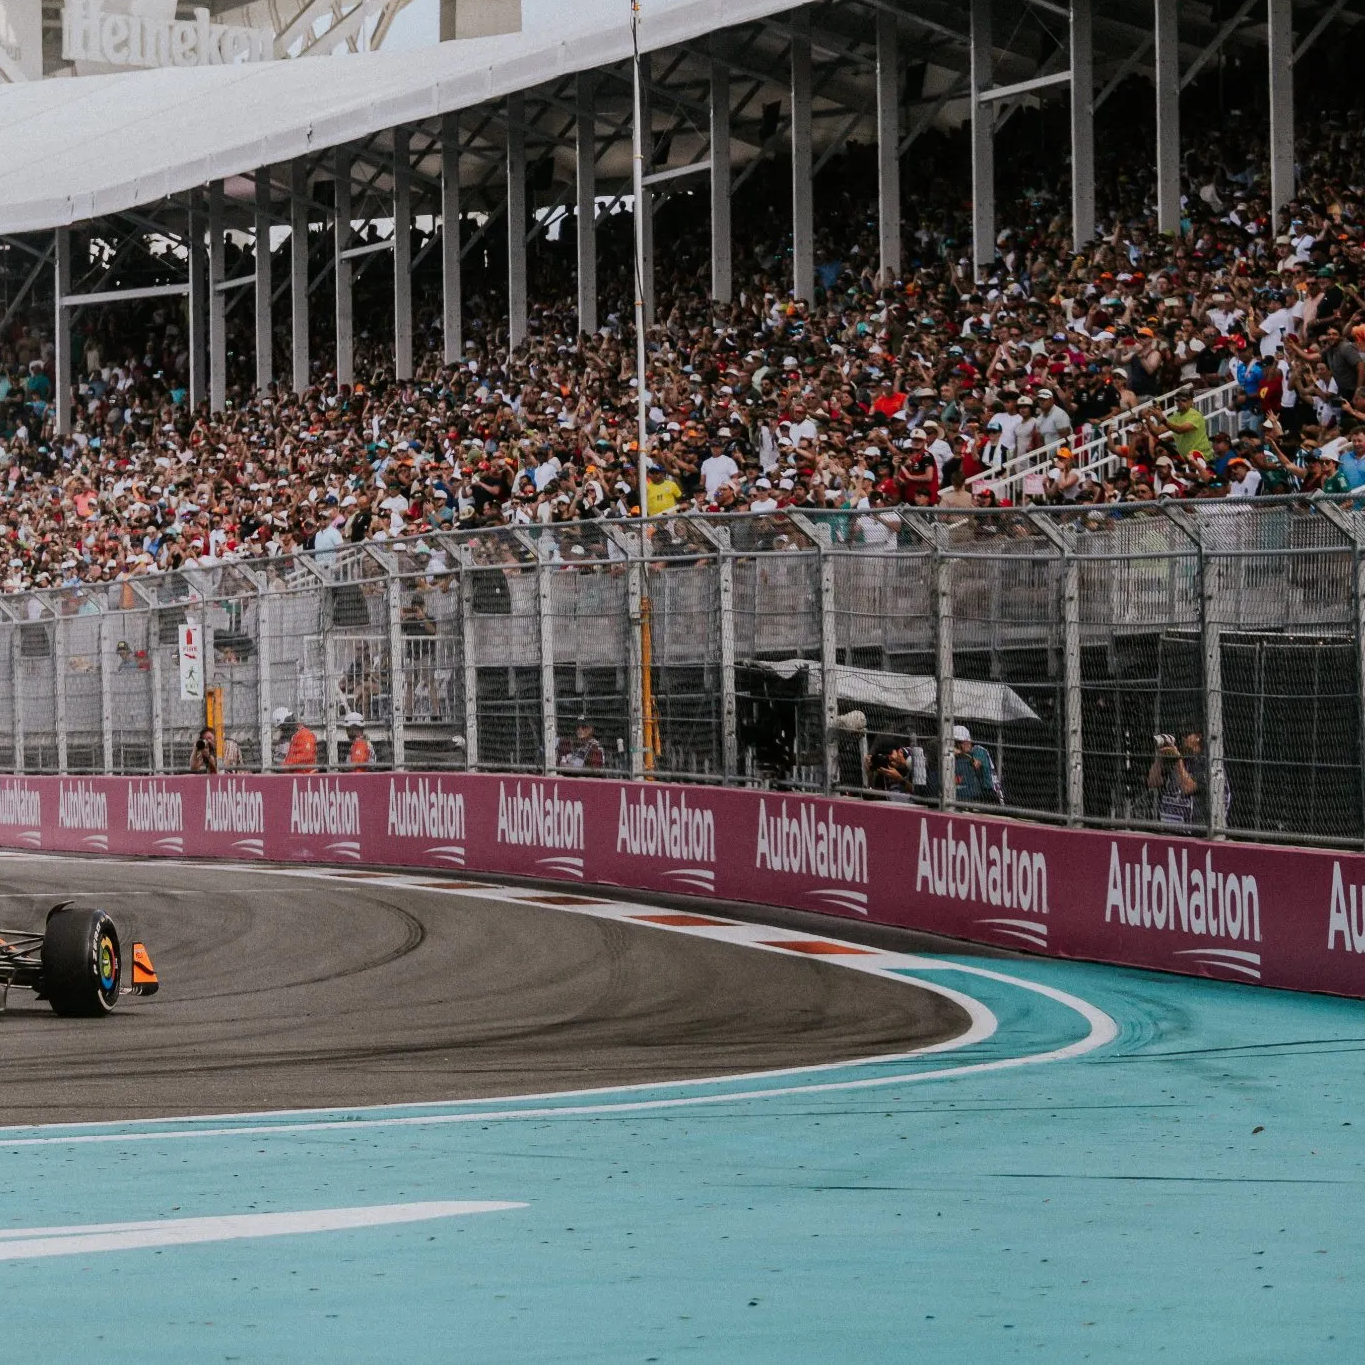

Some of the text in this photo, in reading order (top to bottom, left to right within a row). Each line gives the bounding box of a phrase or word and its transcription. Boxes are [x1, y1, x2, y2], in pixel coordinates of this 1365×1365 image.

[59, 779, 108, 830] AutoNation
[127, 780, 183, 832] AutoNation
[205, 778, 265, 833] AutoNation
[291, 777, 361, 834] AutoNation
[388, 777, 466, 840] AutoNation
[497, 780, 585, 850] AutoNation
[617, 787, 716, 862] AutoNation
[756, 797, 868, 884] AutoNation
[916, 817, 1049, 914] AutoNation
[1105, 841, 1262, 942] AutoNation
